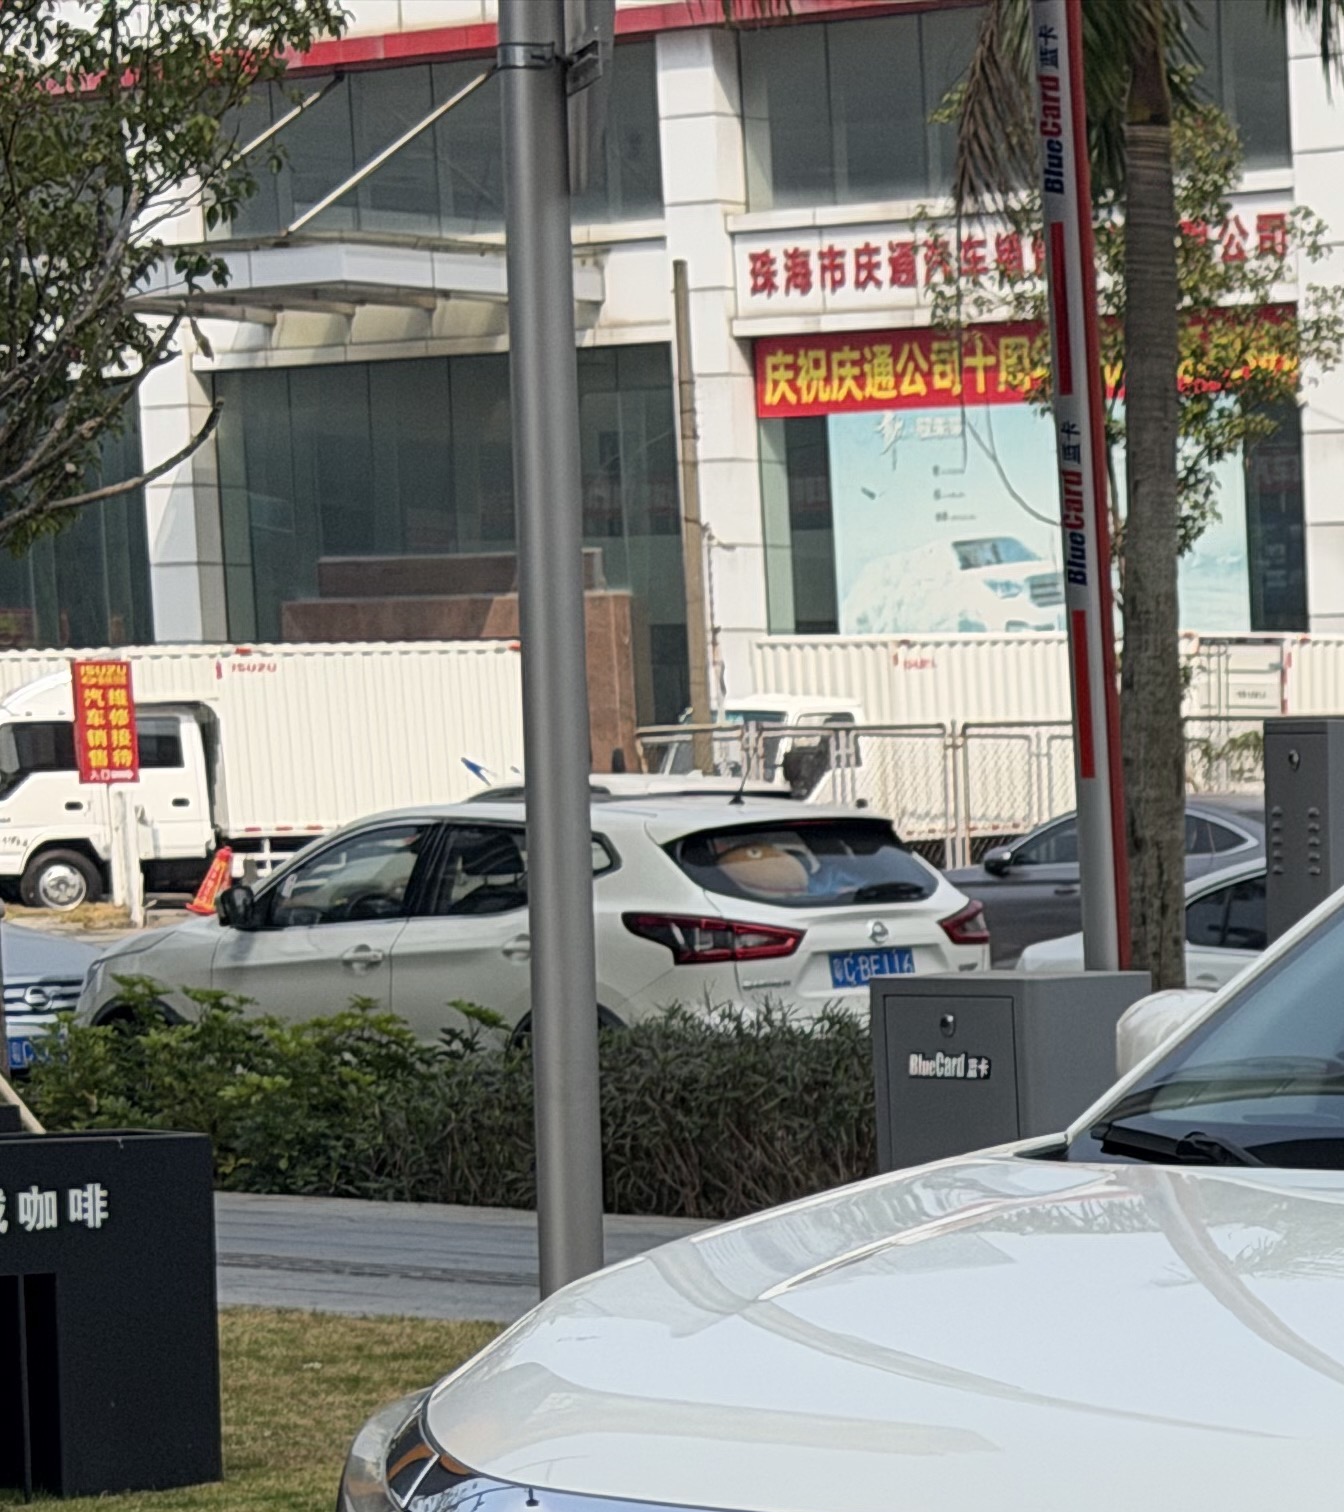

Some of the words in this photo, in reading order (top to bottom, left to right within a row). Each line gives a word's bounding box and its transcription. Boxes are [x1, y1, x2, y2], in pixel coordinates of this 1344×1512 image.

[1037, 74, 1064, 195] BlueCard
[1062, 470, 1088, 587] BlueCard
[908, 1051, 966, 1078] BlueCard
[0, 1182, 109, 1234] 咖啡
